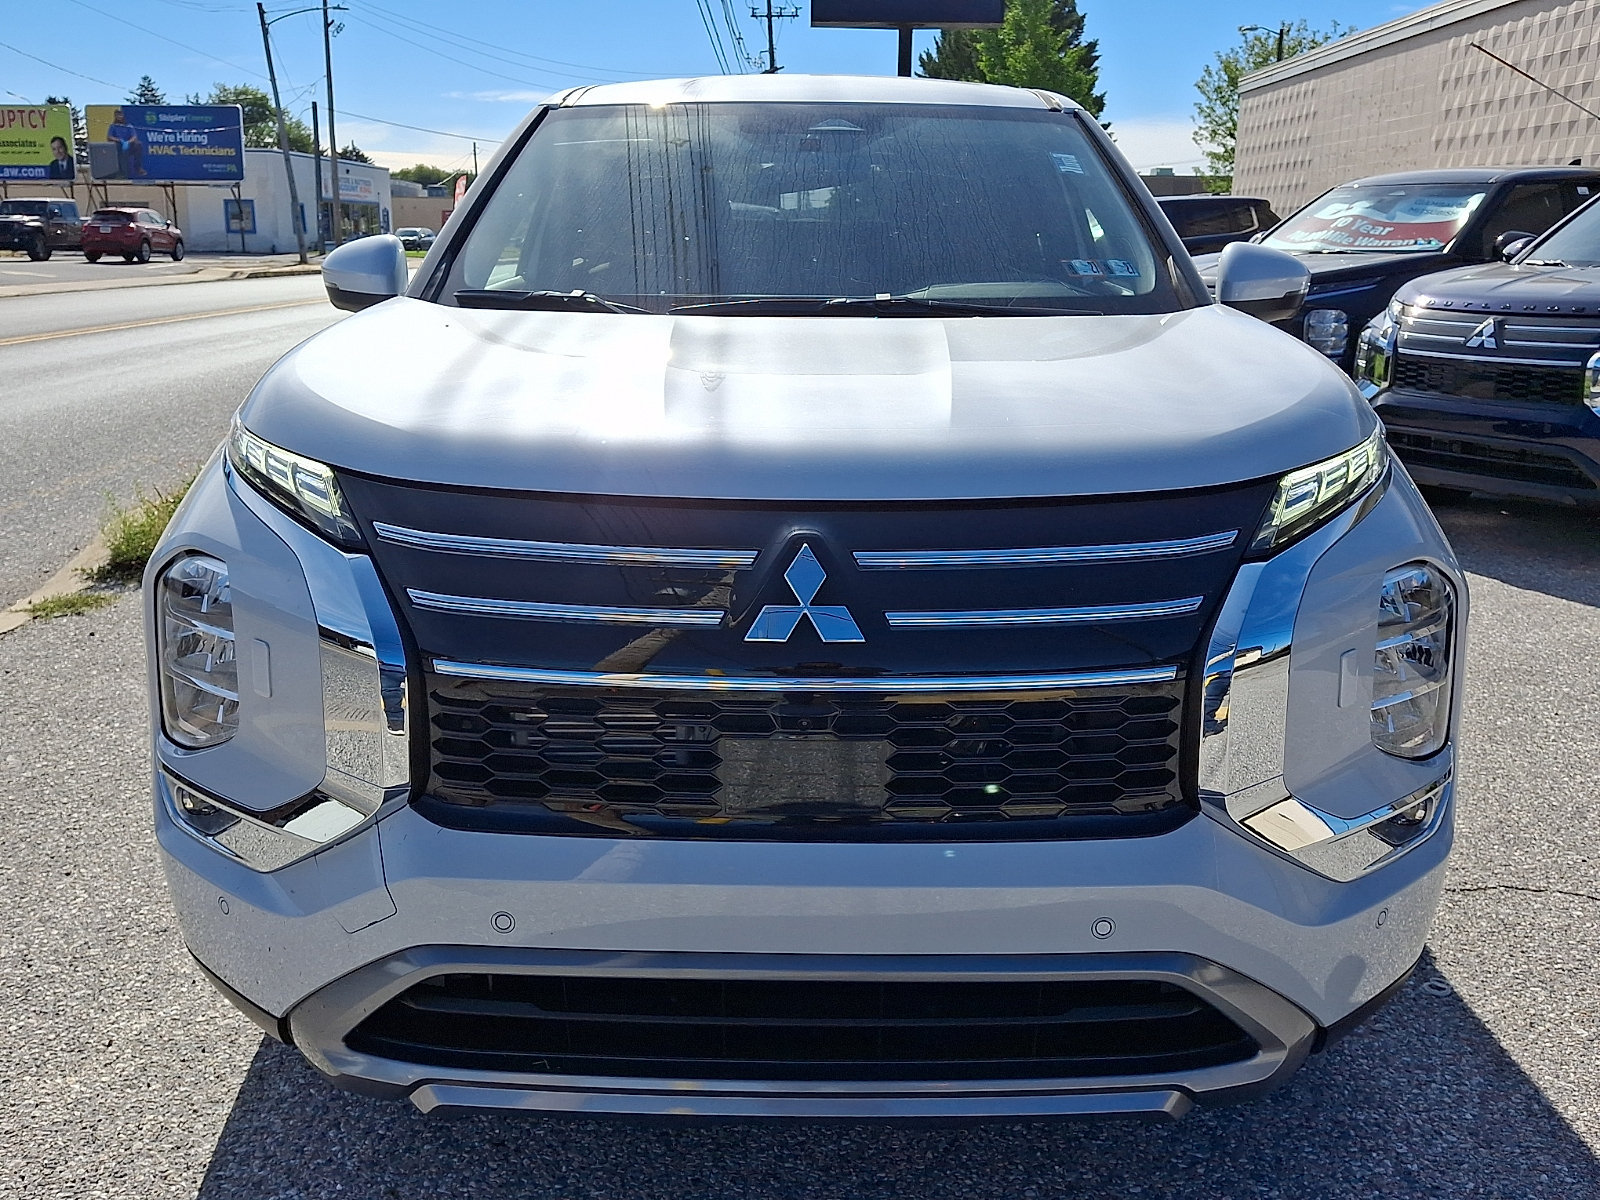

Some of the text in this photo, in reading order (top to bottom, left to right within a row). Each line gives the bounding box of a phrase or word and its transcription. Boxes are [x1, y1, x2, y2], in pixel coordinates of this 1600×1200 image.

[147, 131, 208, 145] We're Hiring
[148, 145, 236, 156] HVAC Technicians
[1351, 219, 1395, 237] Year
[1353, 236, 1444, 247] Warran
